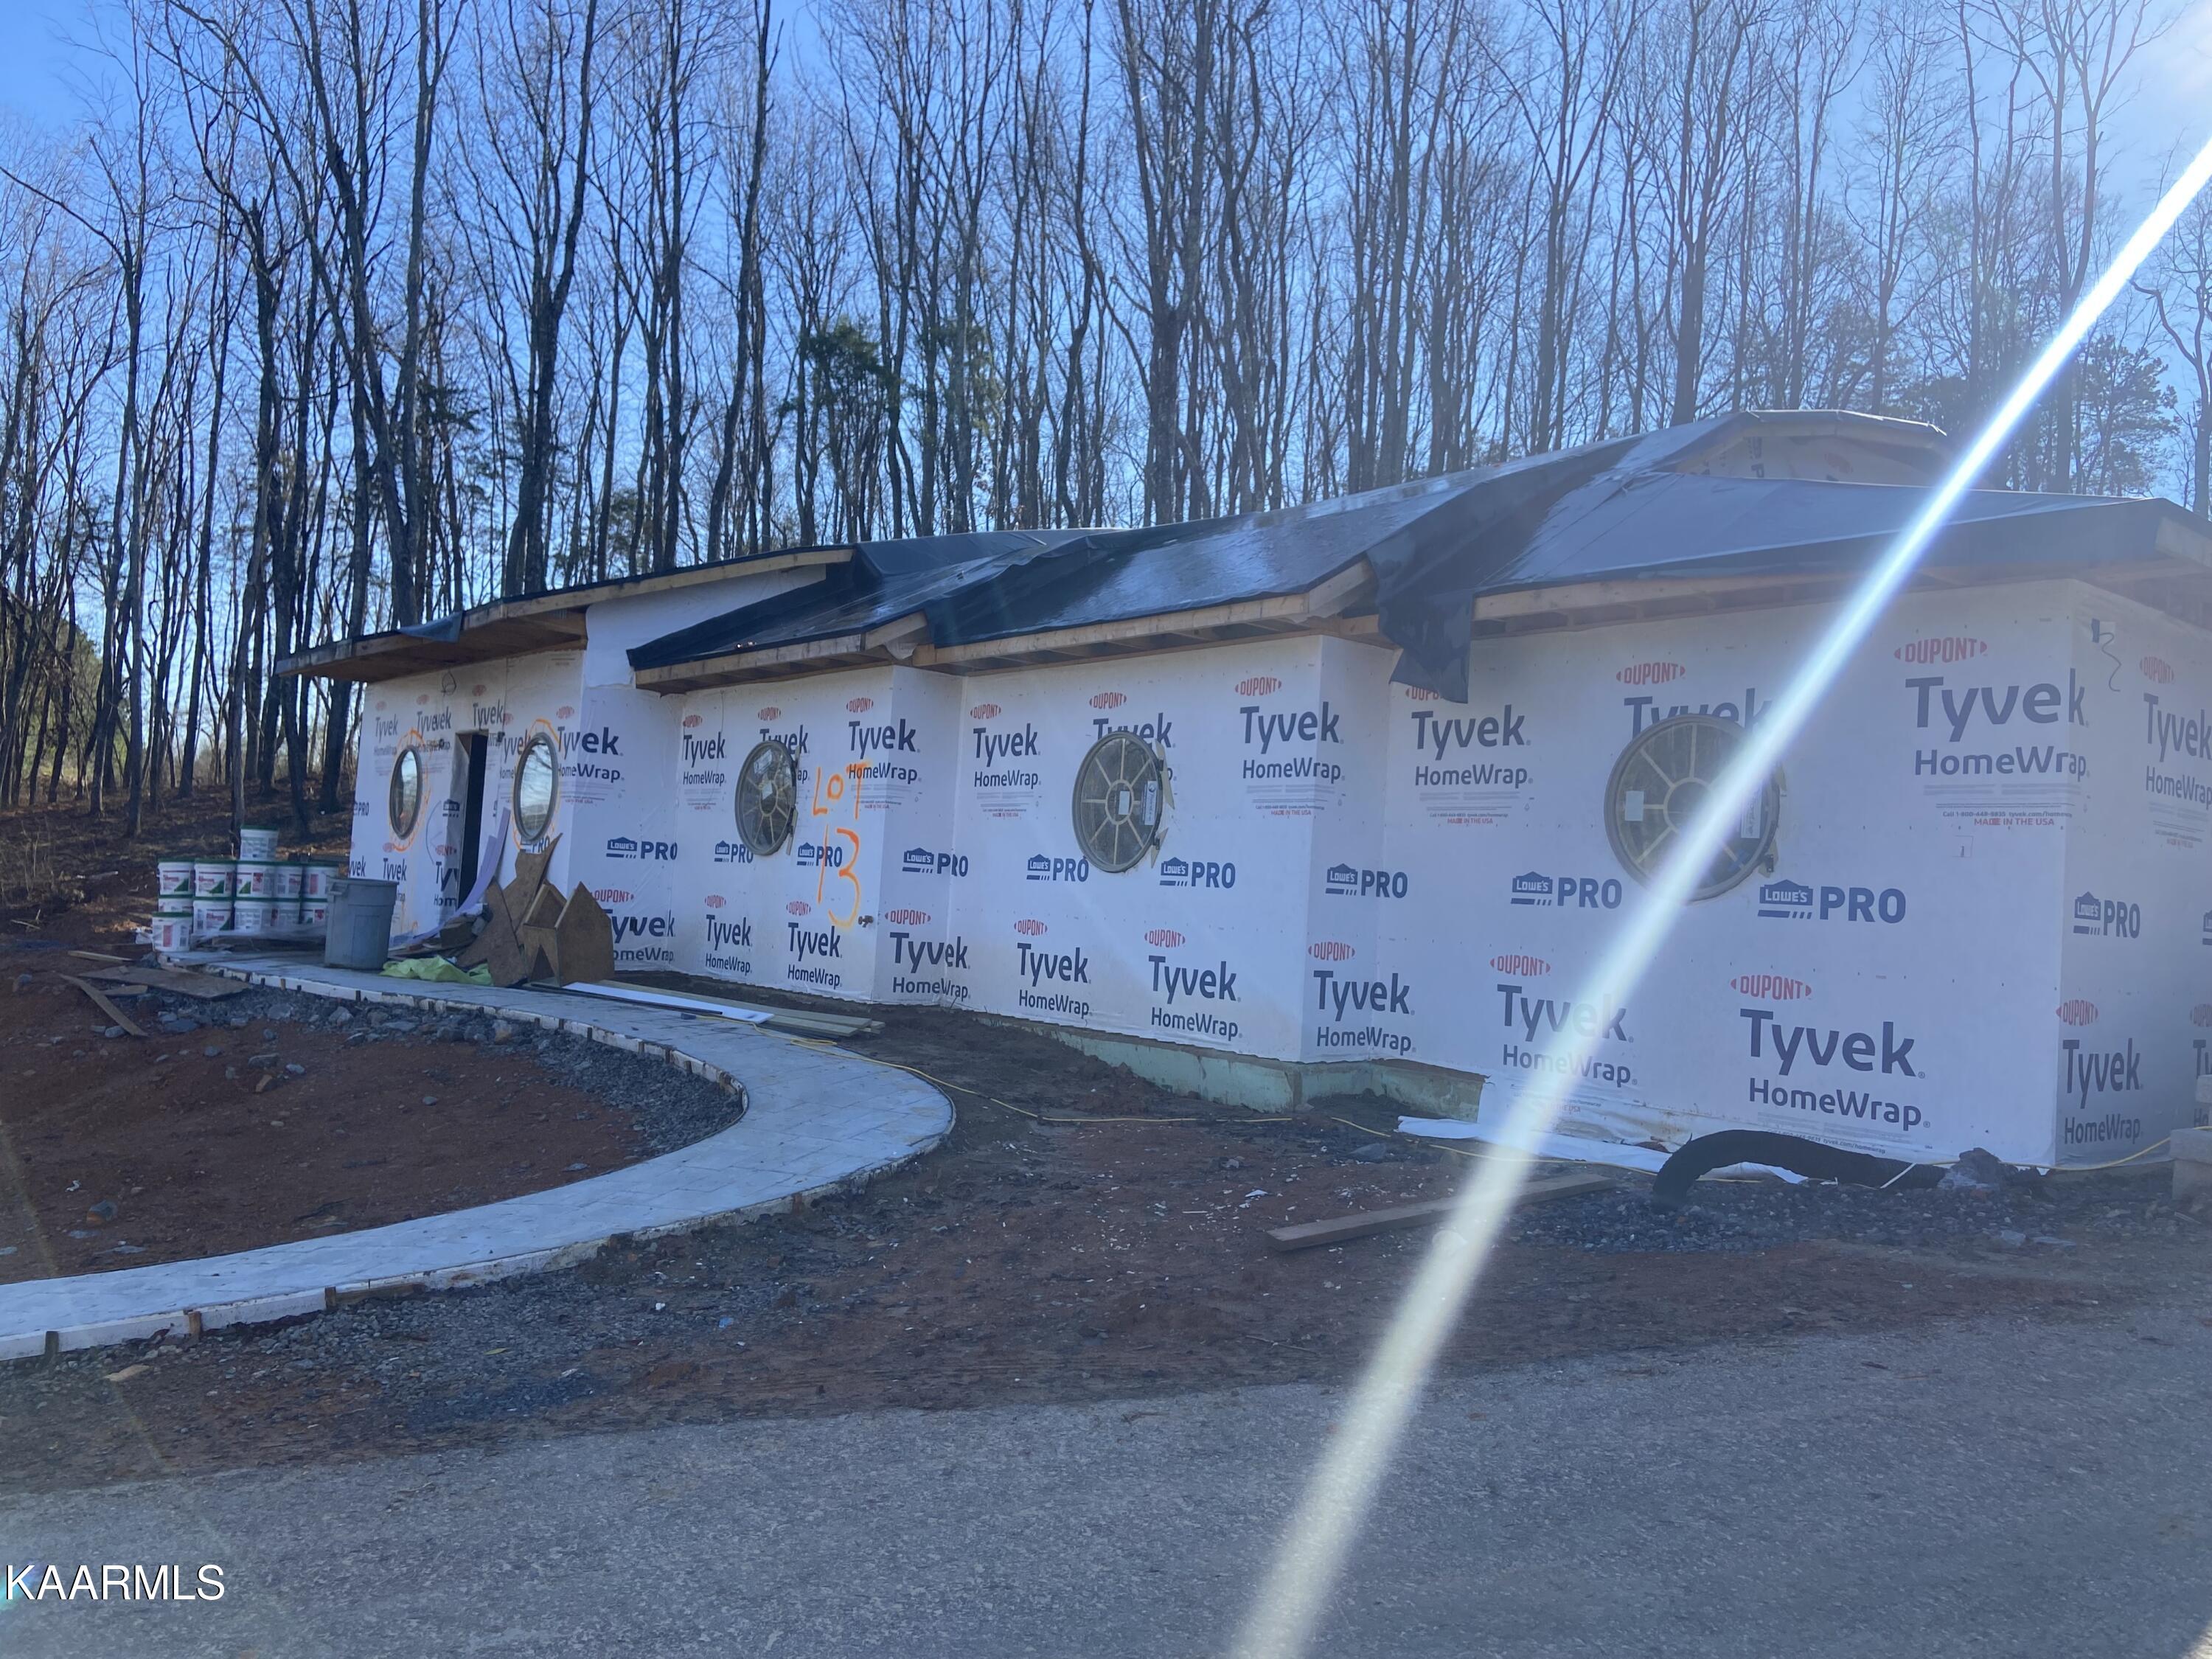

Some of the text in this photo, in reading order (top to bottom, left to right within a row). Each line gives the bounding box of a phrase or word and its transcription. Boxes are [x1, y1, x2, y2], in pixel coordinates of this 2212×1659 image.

[1905, 637, 1977, 664] DUPONT
[1624, 662, 1680, 685] DUPONT
[2143, 657, 2173, 684] DUPONT
[1093, 692, 1122, 709] DUPONT
[1241, 677, 1277, 697] DUPONT
[1411, 686, 1439, 701] DUPO
[473, 699, 504, 731] Tyvek
[849, 698, 872, 713] DUPONT
[973, 703, 998, 720] DUPONT
[1624, 688, 1773, 739] Tek
[1905, 668, 2085, 742] Tyvek
[375, 714, 398, 743] Tyvek
[848, 718, 917, 759] Tyvek
[1093, 712, 1172, 748] Tek
[1239, 701, 1340, 754] Tyvek
[1411, 704, 1526, 760] Tyvek
[557, 726, 619, 760] Tyvek
[684, 731, 726, 768] Tyvek
[973, 723, 1038, 768] Tyvek
[849, 762, 917, 785] HomeWrap
[1242, 757, 1340, 784] HomeWrap
[1415, 764, 1528, 788] HomeWrap
[1915, 745, 2086, 781] HomeWrap
[683, 770, 725, 787] HomeWrap
[974, 770, 1038, 790] HomeWrap
[358, 801, 369, 816] PRO
[610, 841, 678, 860] LOWE'S PRO
[731, 844, 754, 863] PRO
[816, 846, 843, 867] PRO
[383, 858, 407, 881] Tyvek
[817, 824, 861, 928] 13
[905, 852, 968, 877] LOWE'S PRO
[1053, 858, 1089, 882] PRO
[1164, 861, 1236, 888] LOWE'S PRO
[594, 889, 630, 902] DUPONT
[1330, 869, 1408, 899] LOWE'S PRO
[1516, 877, 1622, 909] LOWE'S PRO
[788, 901, 809, 916] DUPONT
[890, 909, 927, 925] DUPONT
[1764, 886, 1906, 924] LOWE'S PRO
[706, 914, 751, 950] Tyvek
[1018, 919, 1045, 936] DUPONT
[2104, 900, 2140, 939] PRO
[787, 922, 841, 961] Tyvek
[1149, 929, 1182, 948] DUPONT
[1314, 942, 1351, 961] DUPONT
[613, 947, 674, 964] omeWrap
[705, 953, 751, 975] HomeWrap
[889, 932, 968, 974] Tyvek
[1017, 942, 1088, 987] Tyvek
[1497, 955, 1545, 976] DUPONT
[787, 964, 840, 990] HomeWrap
[893, 977, 968, 1001] HomeWrap
[1148, 955, 1237, 1004] Tyvek
[1740, 975, 1804, 1000] DUPONT
[1019, 990, 1089, 1019] HomeWrap
[1314, 970, 1410, 1021] Tyvek
[1151, 1007, 1238, 1041] HomeWrap
[1497, 984, 1627, 1042] Tyvek
[2063, 999, 2095, 1026] DUPONT
[1317, 1026, 1411, 1055] HomeWrap
[1740, 1009, 1916, 1077] Tyvek
[1503, 1044, 1631, 1087] HomeWrap
[2062, 1038, 2140, 1109] Tyvek
[1750, 1077, 1921, 1131] HomeWrap
[2064, 1113, 2140, 1144] HomeWrap
